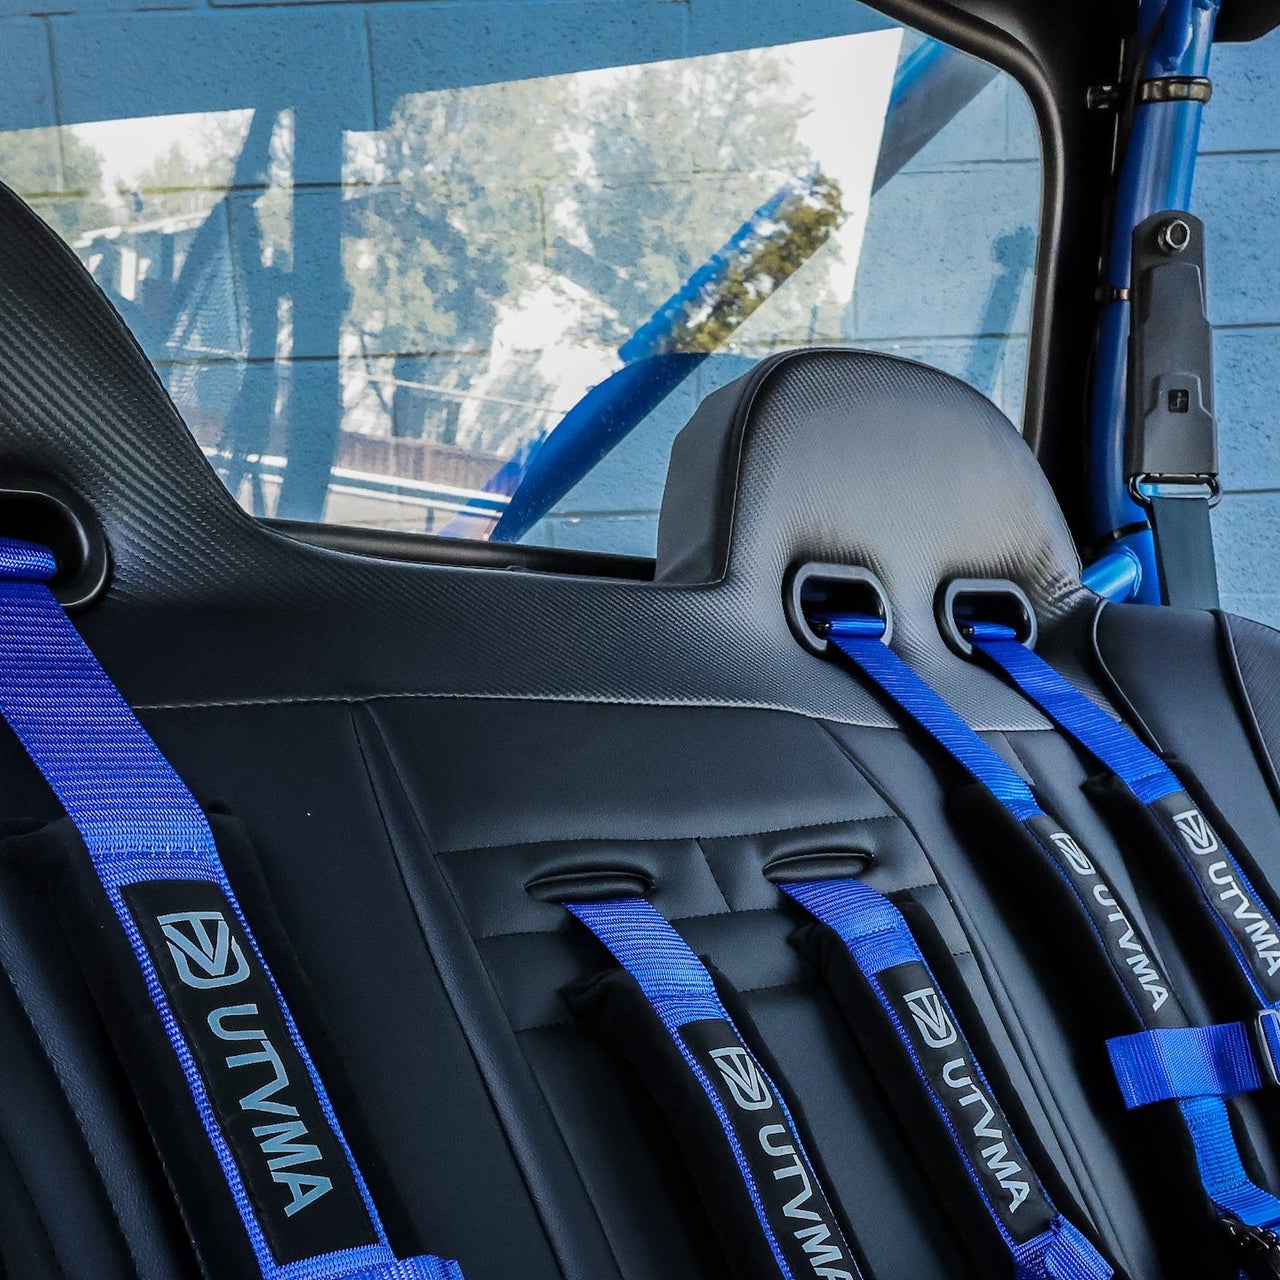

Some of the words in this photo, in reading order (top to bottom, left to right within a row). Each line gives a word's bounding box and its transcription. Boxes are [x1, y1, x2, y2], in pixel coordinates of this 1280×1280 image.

[1092, 883, 1169, 1011] UTVMA
[207, 1004, 333, 1217] UTVMA
[941, 1057, 1032, 1213] UTVMA
